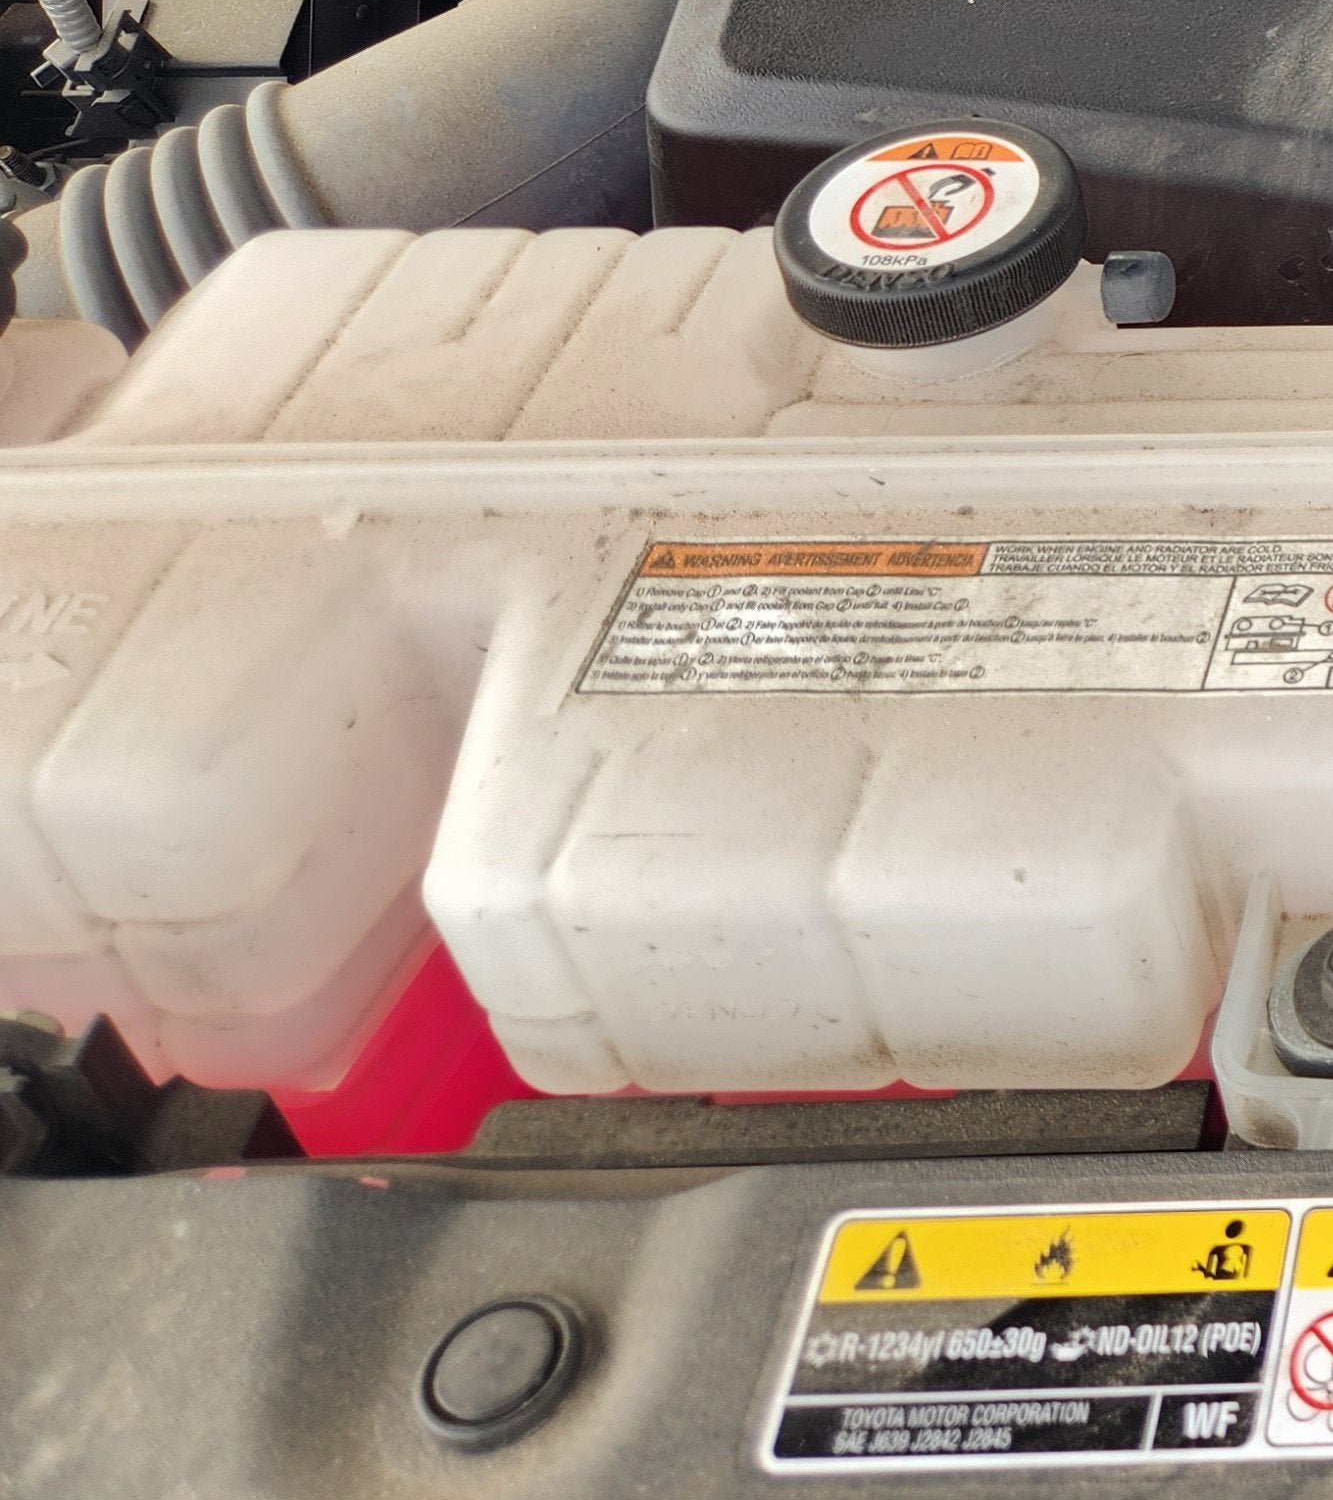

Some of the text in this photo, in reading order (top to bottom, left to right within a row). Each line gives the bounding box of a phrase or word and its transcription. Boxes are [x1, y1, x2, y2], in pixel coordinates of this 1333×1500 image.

[861, 254, 928, 267] 108kPa
[814, 263, 957, 292] DENSO
[996, 545, 1034, 553] WORK
[1156, 546, 1218, 554] RADIATOR
[1221, 546, 1245, 554] ARE
[1238, 553, 1304, 562] RADIATEUR
[683, 551, 974, 568] WARNING AVERTISSEMENT ADVERTENCIA
[1121, 564, 1166, 572] MOTOR
[1201, 1321, 1262, 1358] (POE)
[841, 1401, 1090, 1429] TOYOTA MOTOR CORPORATION
[1182, 1402, 1240, 1439] WF
